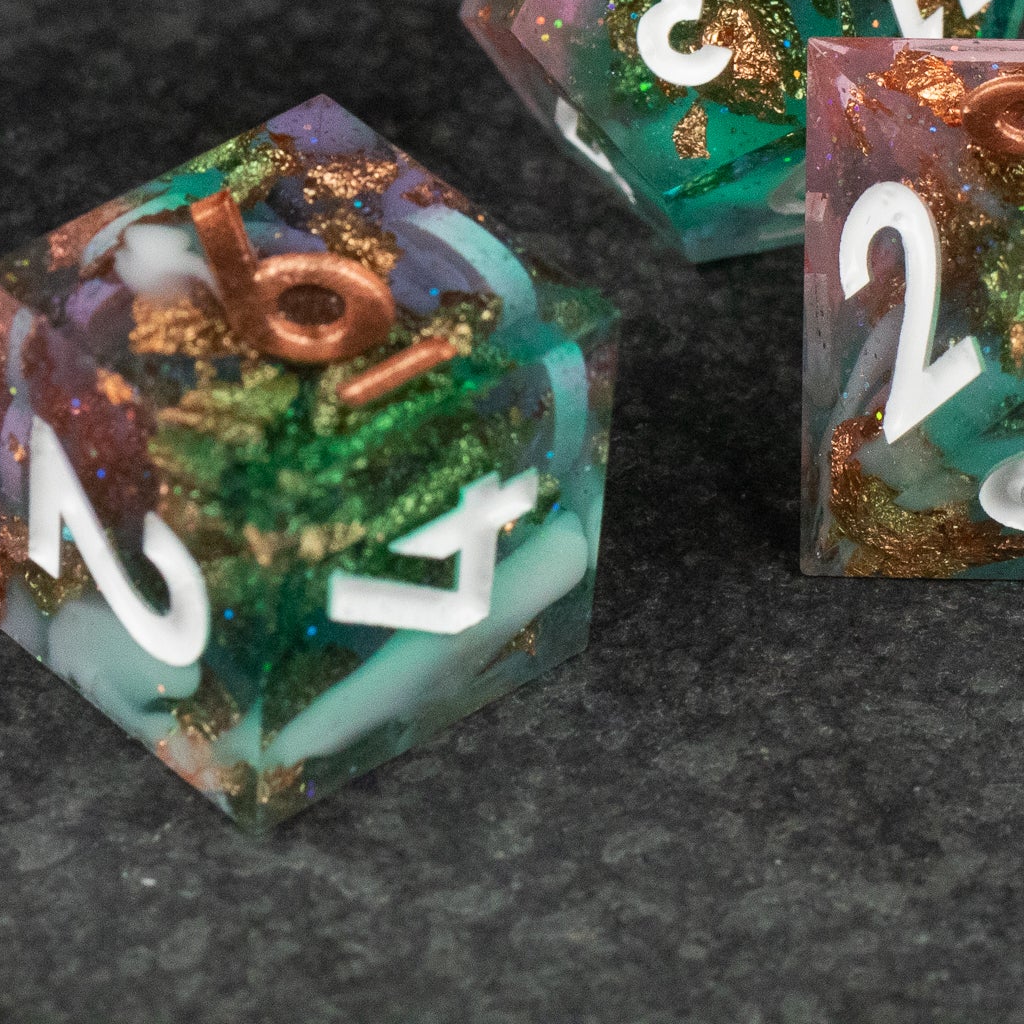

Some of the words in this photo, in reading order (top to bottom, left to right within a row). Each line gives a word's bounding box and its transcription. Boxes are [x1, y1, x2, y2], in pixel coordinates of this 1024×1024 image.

[191, 190, 396, 363] 6
[838, 181, 985, 445] 2
[28, 417, 209, 667] 2
[329, 469, 539, 634] 4
